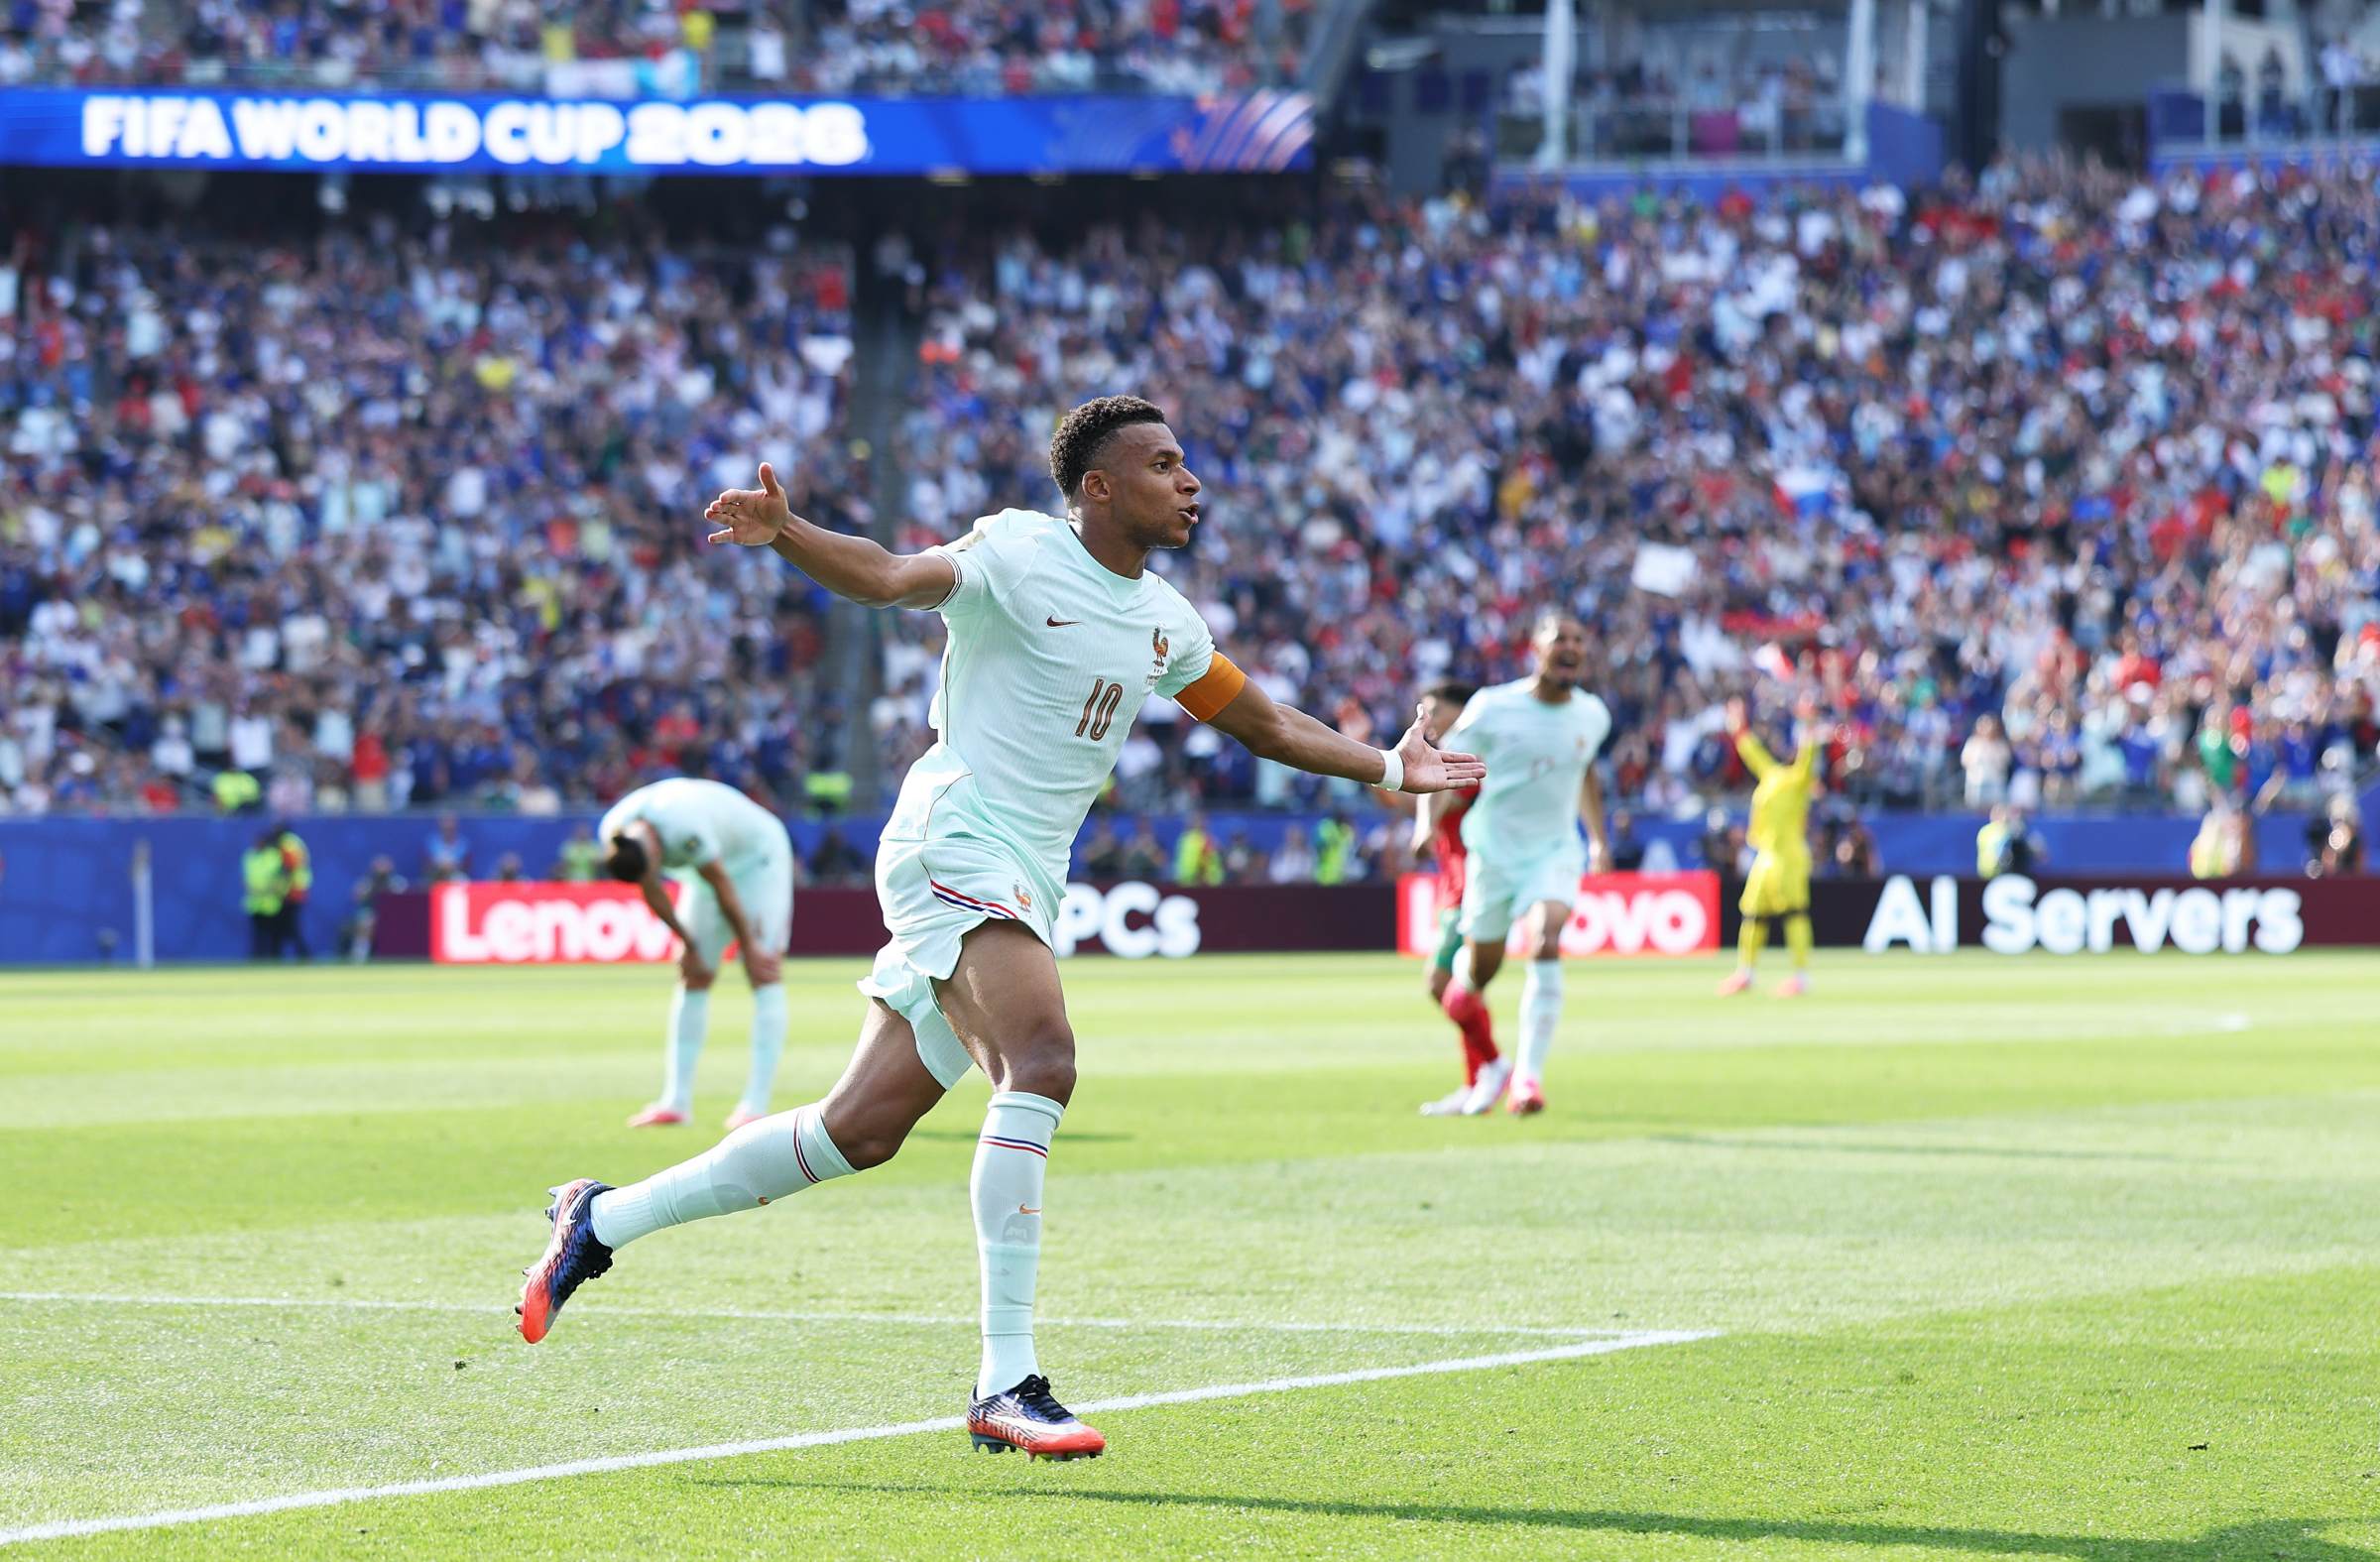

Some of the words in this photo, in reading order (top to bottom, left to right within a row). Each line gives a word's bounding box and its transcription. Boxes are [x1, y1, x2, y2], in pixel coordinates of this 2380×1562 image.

[83, 97, 232, 159] FIFA
[234, 100, 482, 162] WORLD
[484, 103, 624, 163] CUP
[626, 103, 868, 165] 2026
[1075, 675, 1124, 742] 10
[440, 884, 674, 962] Lenov
[1050, 881, 1201, 959] PCs
[1407, 877, 1708, 955] Lovo
[1862, 875, 1958, 954] AI
[1982, 873, 2304, 954] Servers
